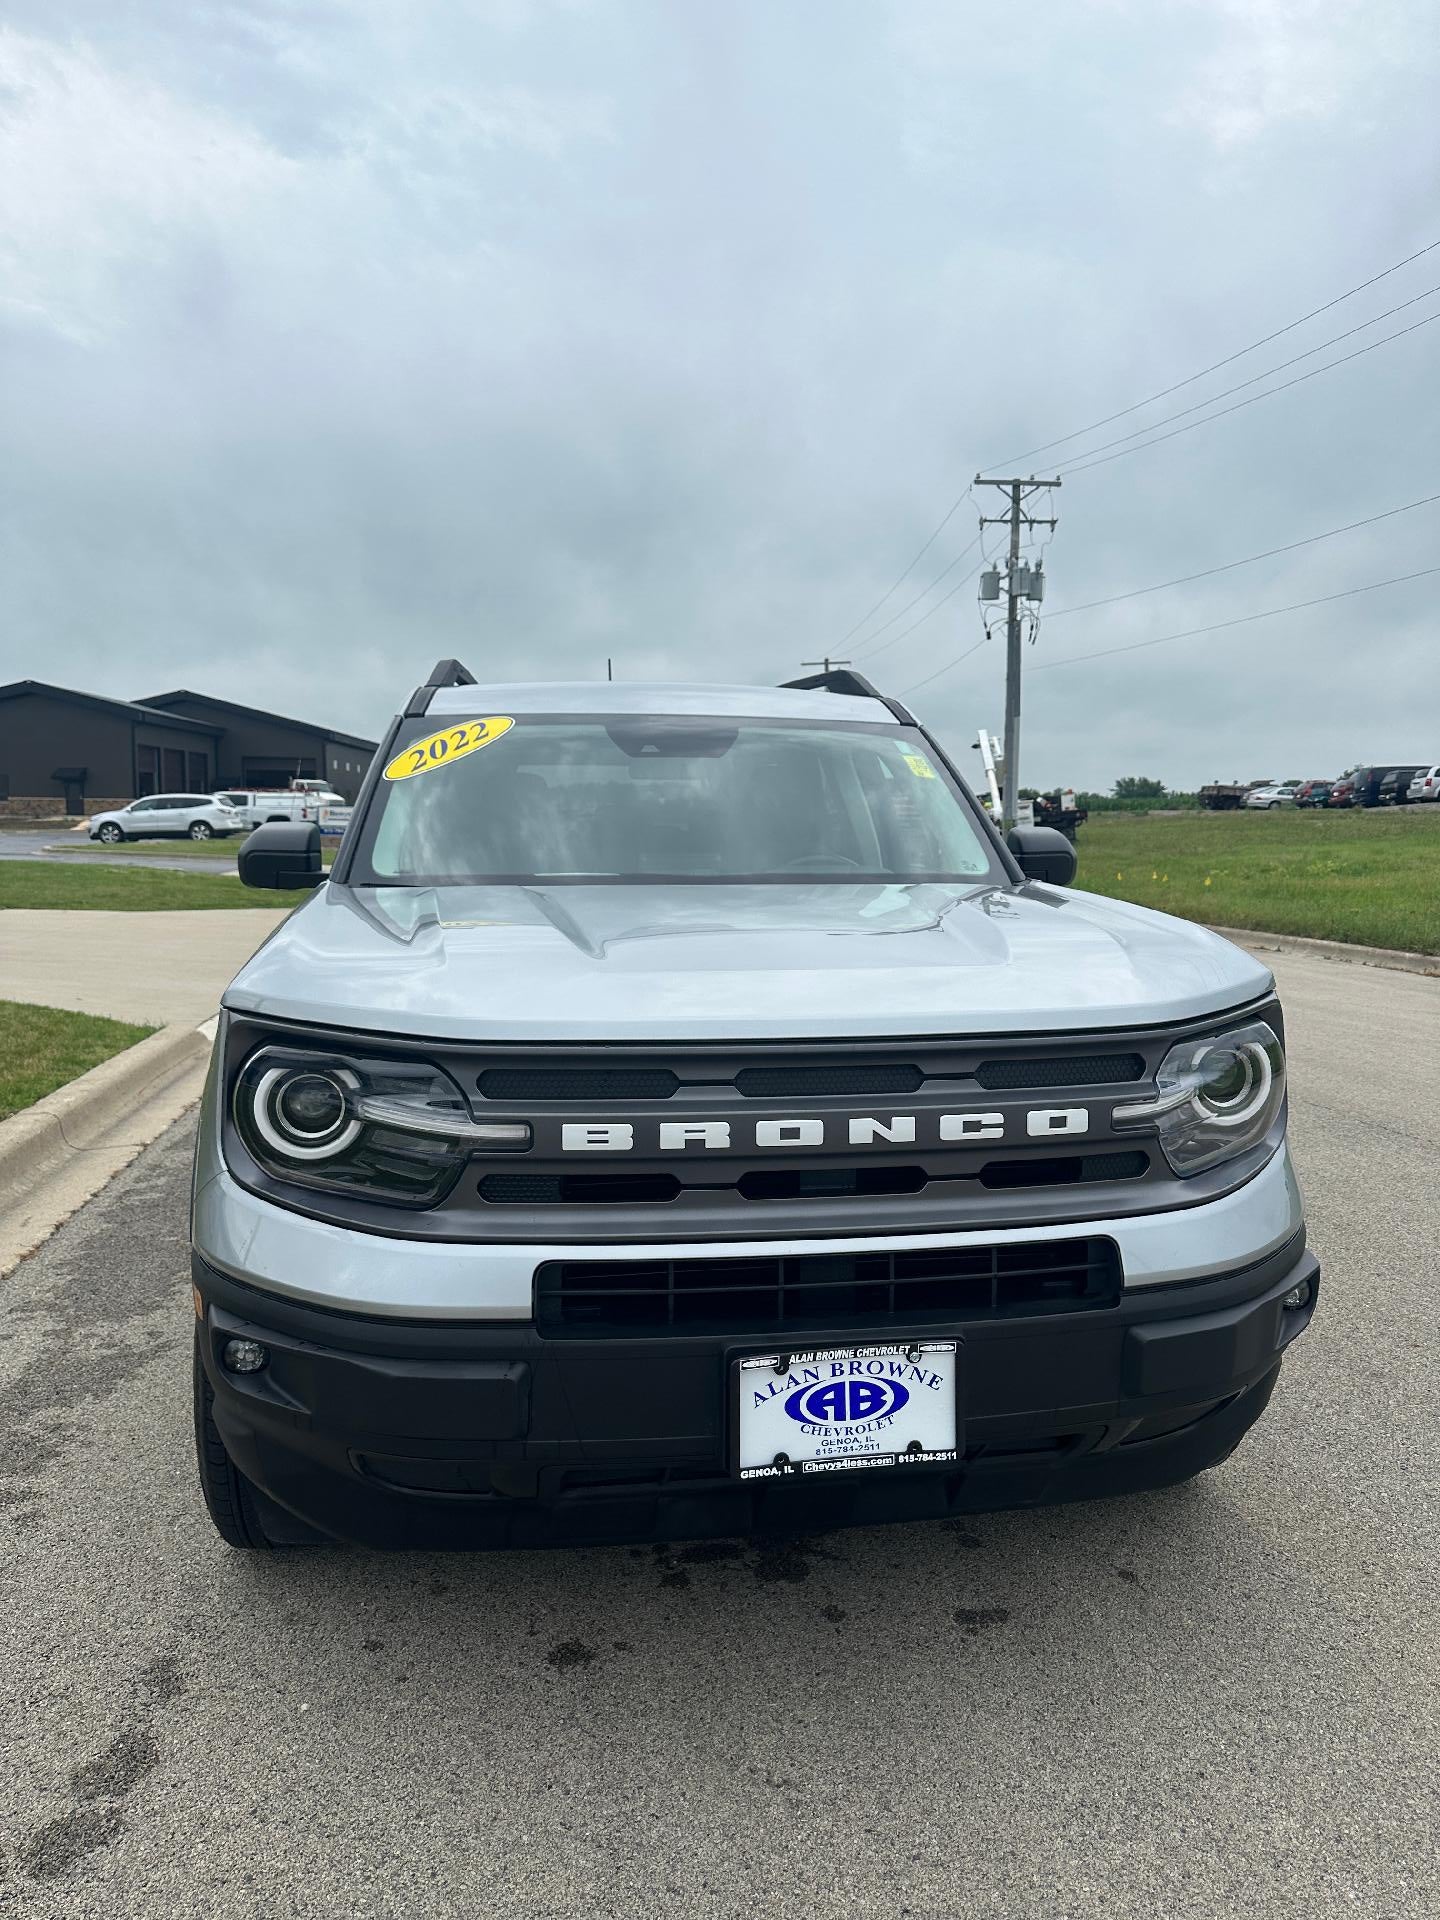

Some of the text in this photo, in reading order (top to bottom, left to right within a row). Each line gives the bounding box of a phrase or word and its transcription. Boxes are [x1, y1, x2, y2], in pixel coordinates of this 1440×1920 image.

[408, 722, 490, 772] 2022
[562, 1108, 1089, 1151] BRONCO
[789, 1345, 911, 1365] ALAN BROWNE CHEVROLET
[753, 1360, 944, 1409] ALAN BROWNE
[806, 1381, 888, 1421] AB
[800, 1415, 894, 1437] CHEVROLET
[815, 1443, 880, 1456] 815-784-2511
[821, 1435, 875, 1447] GENOA, IL
[804, 1457, 893, 1471] Chevys4less.com
[898, 1451, 957, 1463] 815-784-2511
[740, 1465, 795, 1479] GENOA, IL
